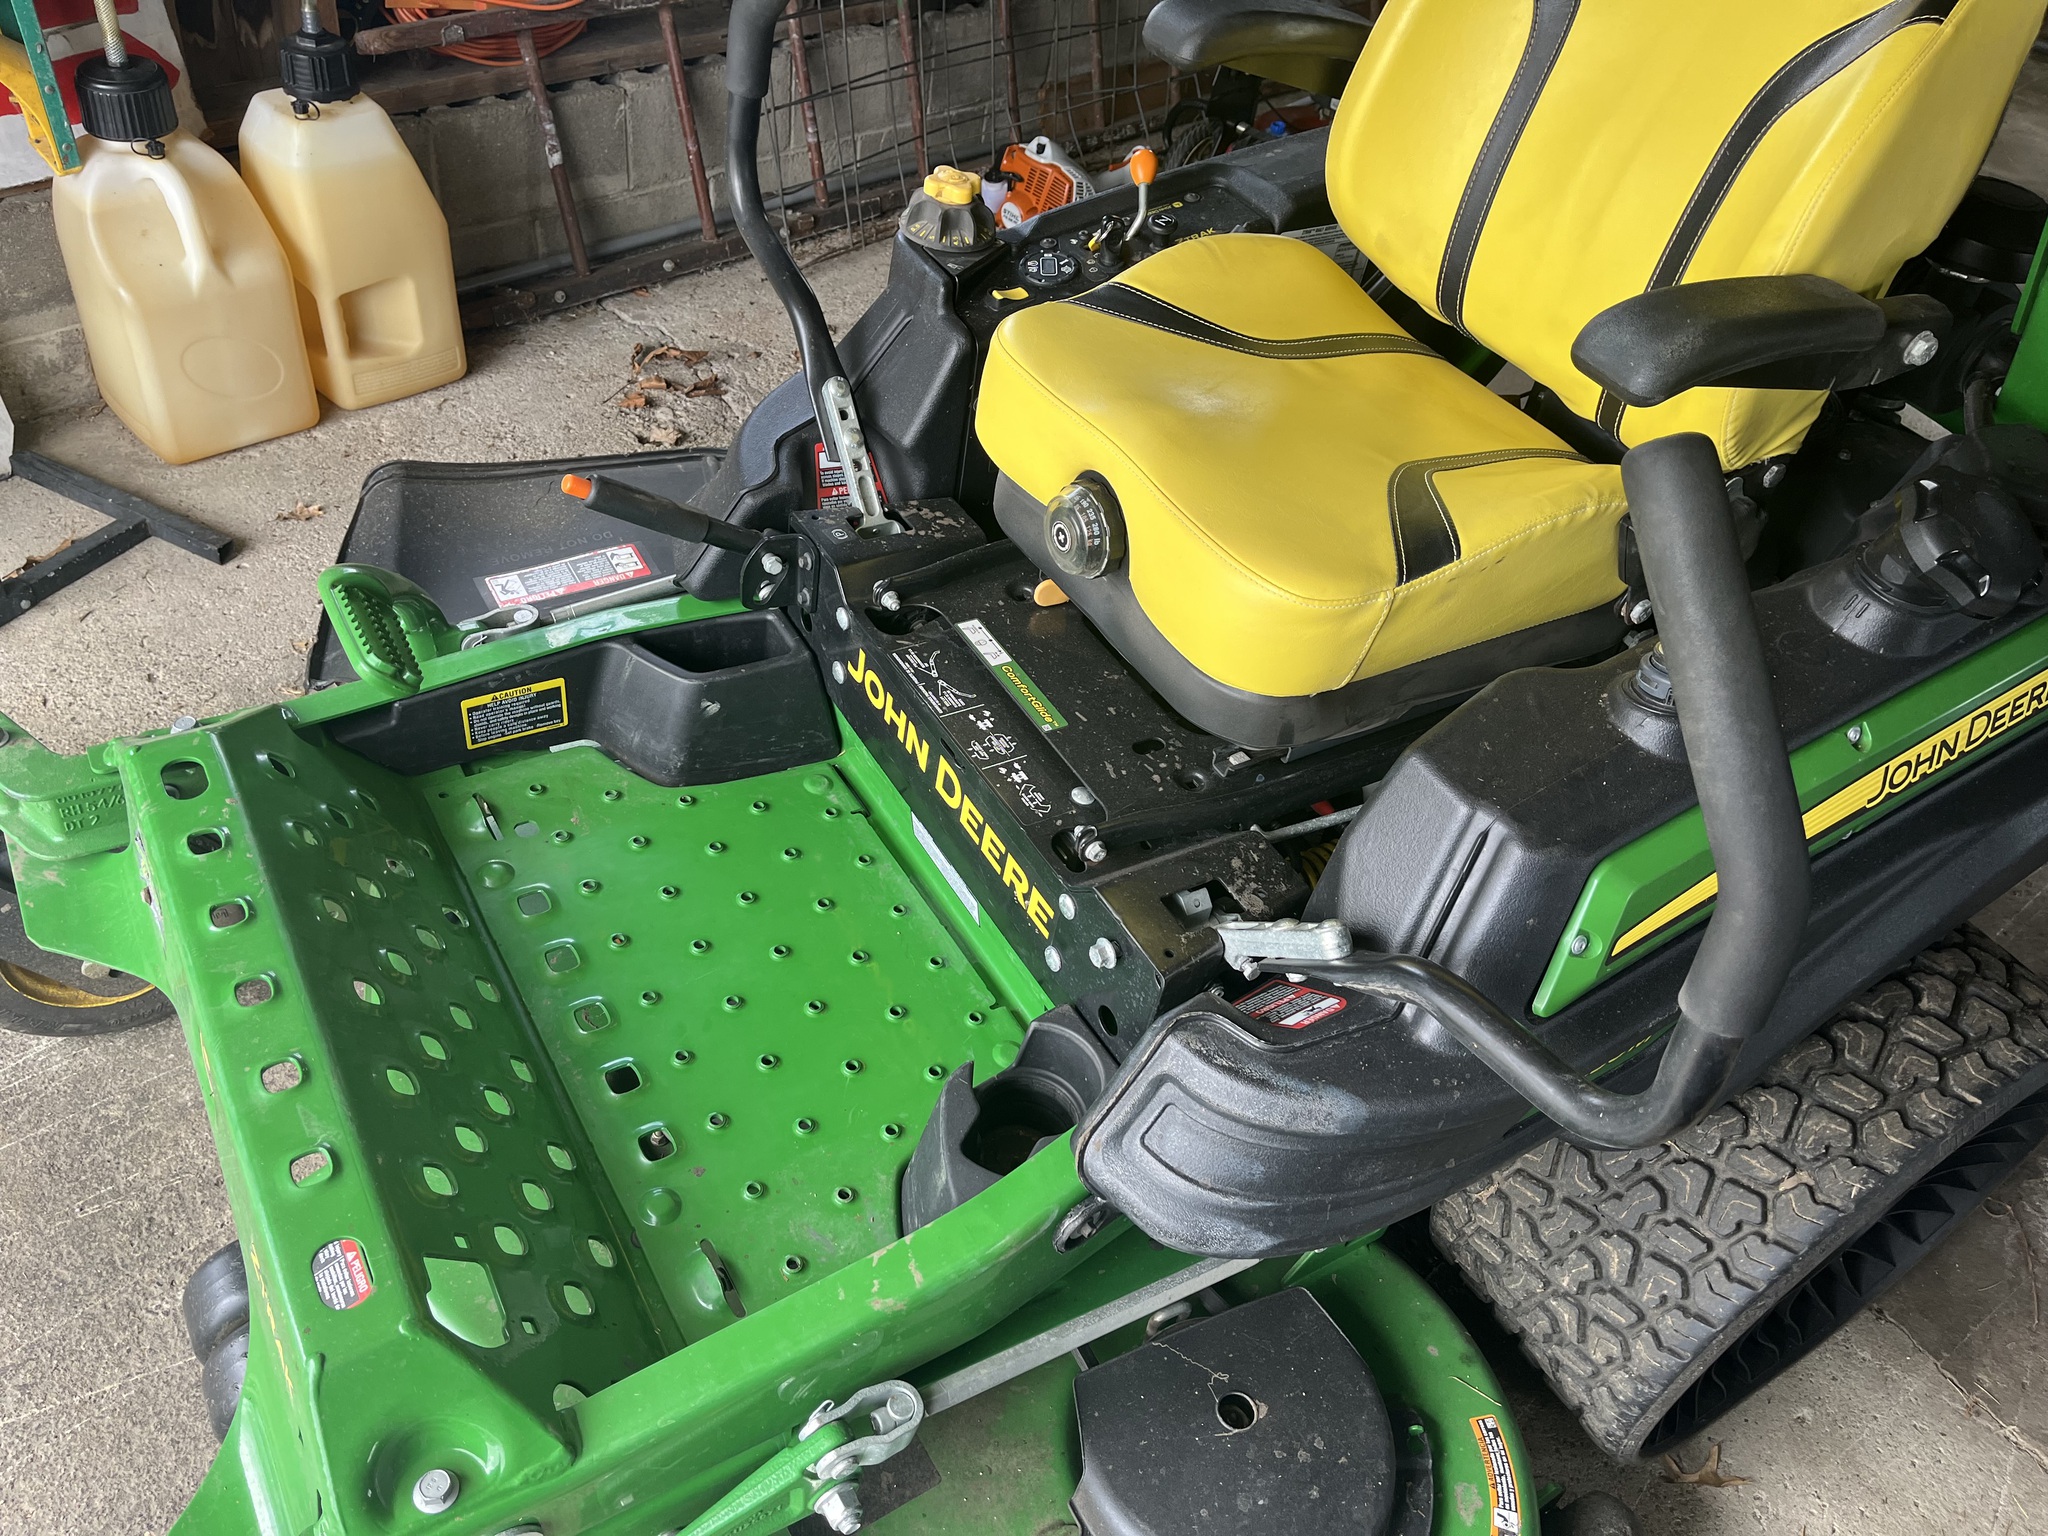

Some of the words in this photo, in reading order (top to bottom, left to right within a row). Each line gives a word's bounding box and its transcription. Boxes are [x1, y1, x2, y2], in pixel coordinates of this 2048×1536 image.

[1003, 208, 1020, 221] STIHL
[1087, 509, 1096, 520] 235
[593, 531, 613, 541] DO
[560, 537, 588, 550] NOT
[490, 544, 553, 566] REMOVE
[593, 573, 627, 586] DANGER
[499, 687, 532, 699] CAUTION
[501, 696, 517, 704] AVOID
[1866, 731, 1961, 808] JOHN
[1964, 681, 2048, 752] DEER
[848, 648, 929, 773] JOHN
[935, 755, 1055, 940] DEERE
[59, 804, 83, 818] RH
[63, 818, 84, 831] DT
[350, 1259, 368, 1293] PELIGRO
[1478, 1437, 1495, 1481] ADVERTENCIA
